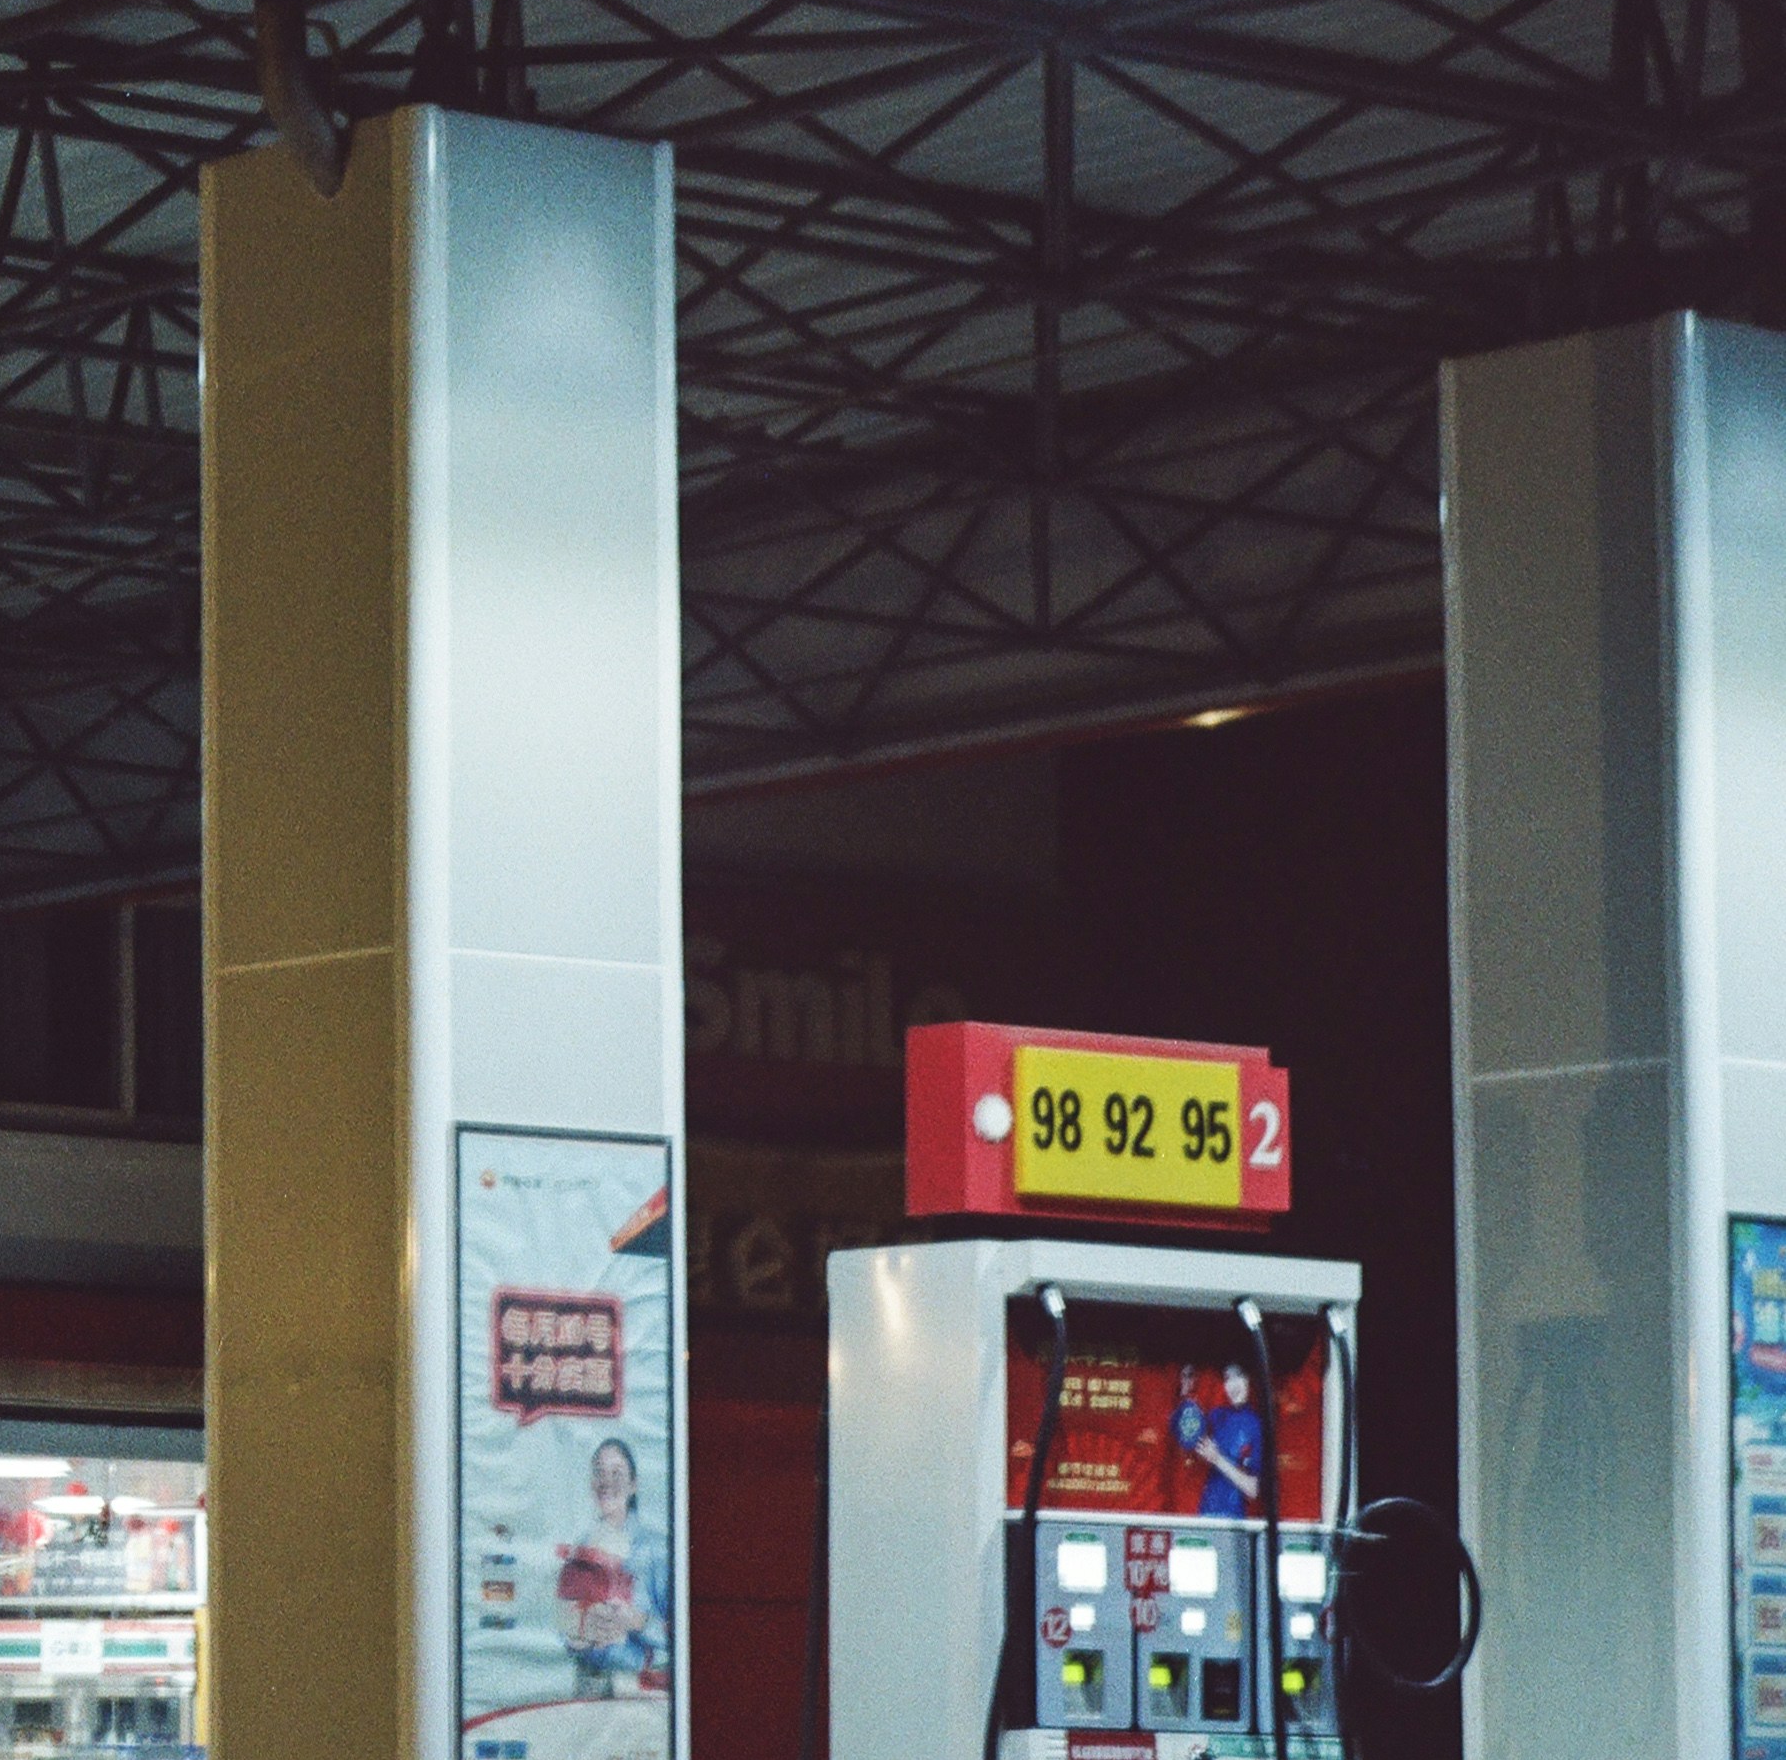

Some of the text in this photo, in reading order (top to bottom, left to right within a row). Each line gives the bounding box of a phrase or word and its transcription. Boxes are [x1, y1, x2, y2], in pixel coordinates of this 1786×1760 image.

[1032, 1086, 1231, 1163] 98 92 95
[1248, 1100, 1282, 1168] 2
